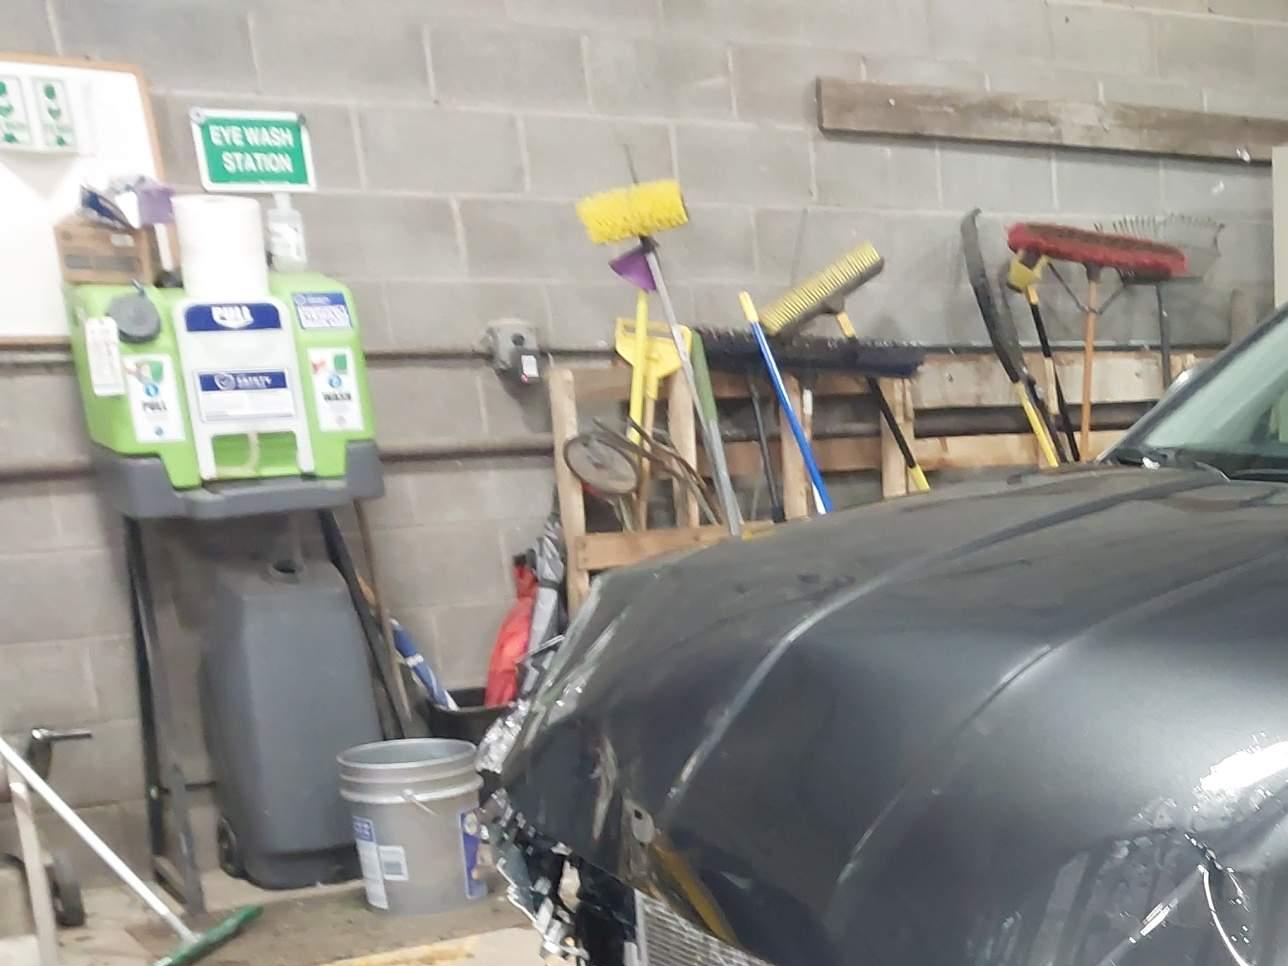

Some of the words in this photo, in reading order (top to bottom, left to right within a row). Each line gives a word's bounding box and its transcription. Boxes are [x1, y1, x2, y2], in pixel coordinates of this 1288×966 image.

[208, 125, 244, 146] EYE
[243, 126, 294, 148] WASH
[221, 151, 293, 173] STATION
